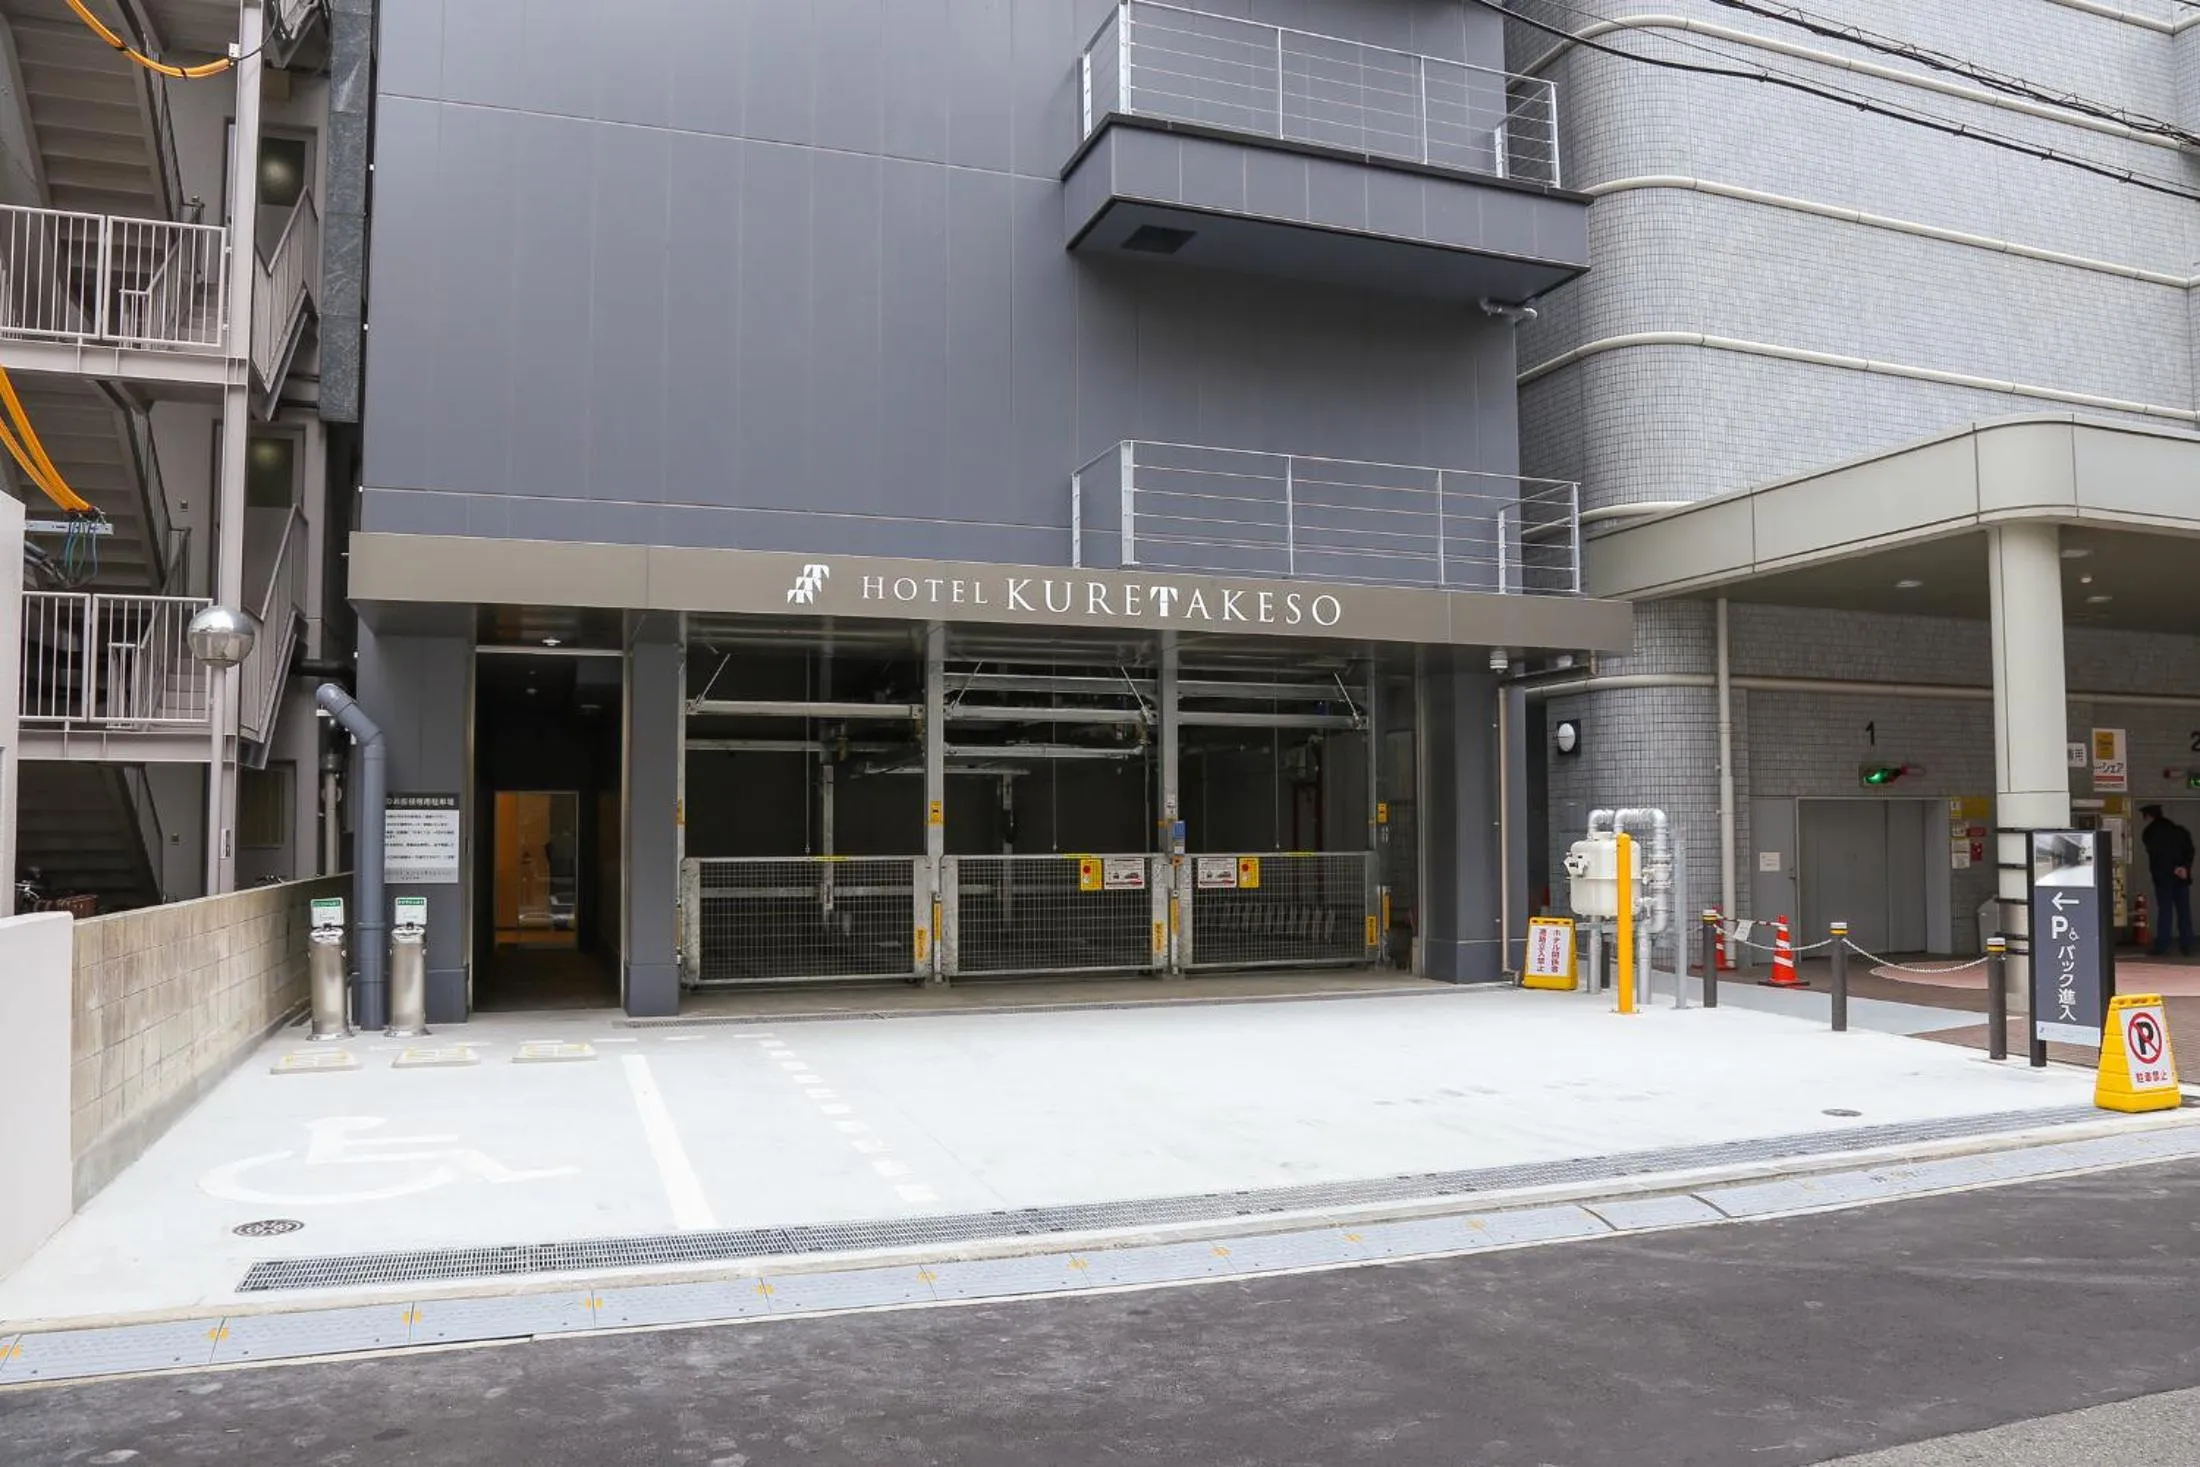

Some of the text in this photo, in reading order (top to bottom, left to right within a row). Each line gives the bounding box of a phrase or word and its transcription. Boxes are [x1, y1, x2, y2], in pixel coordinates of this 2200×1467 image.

[862, 575, 1342, 627] HOTEL KURETAKESO
[1865, 721, 1875, 746] 1
[2190, 731, 2200, 752] 2
[2051, 915, 2069, 940] P
[2057, 944, 2077, 1022] バック進入
